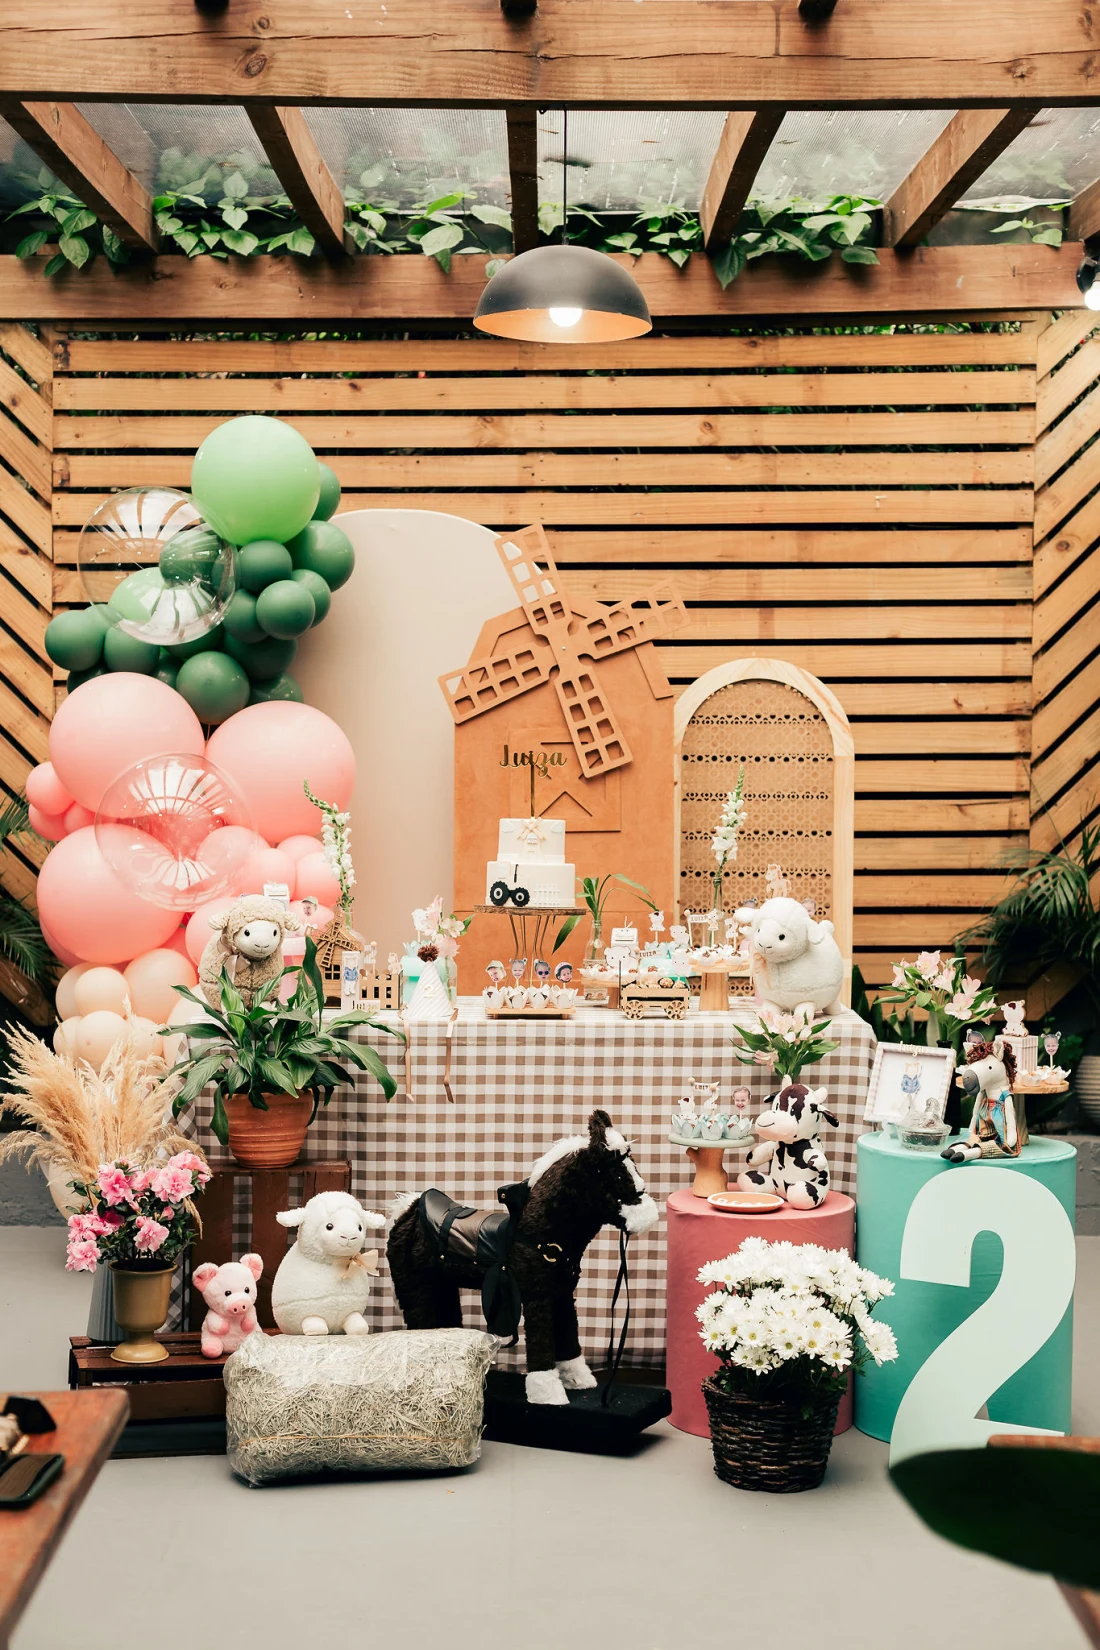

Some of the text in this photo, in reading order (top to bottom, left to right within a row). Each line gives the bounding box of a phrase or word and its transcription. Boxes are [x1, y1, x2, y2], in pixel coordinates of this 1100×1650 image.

[500, 744, 567, 778] Luiza
[724, 917, 738, 938] 2
[639, 950, 657, 958] LUIZA
[889, 1165, 1077, 1470] 2
